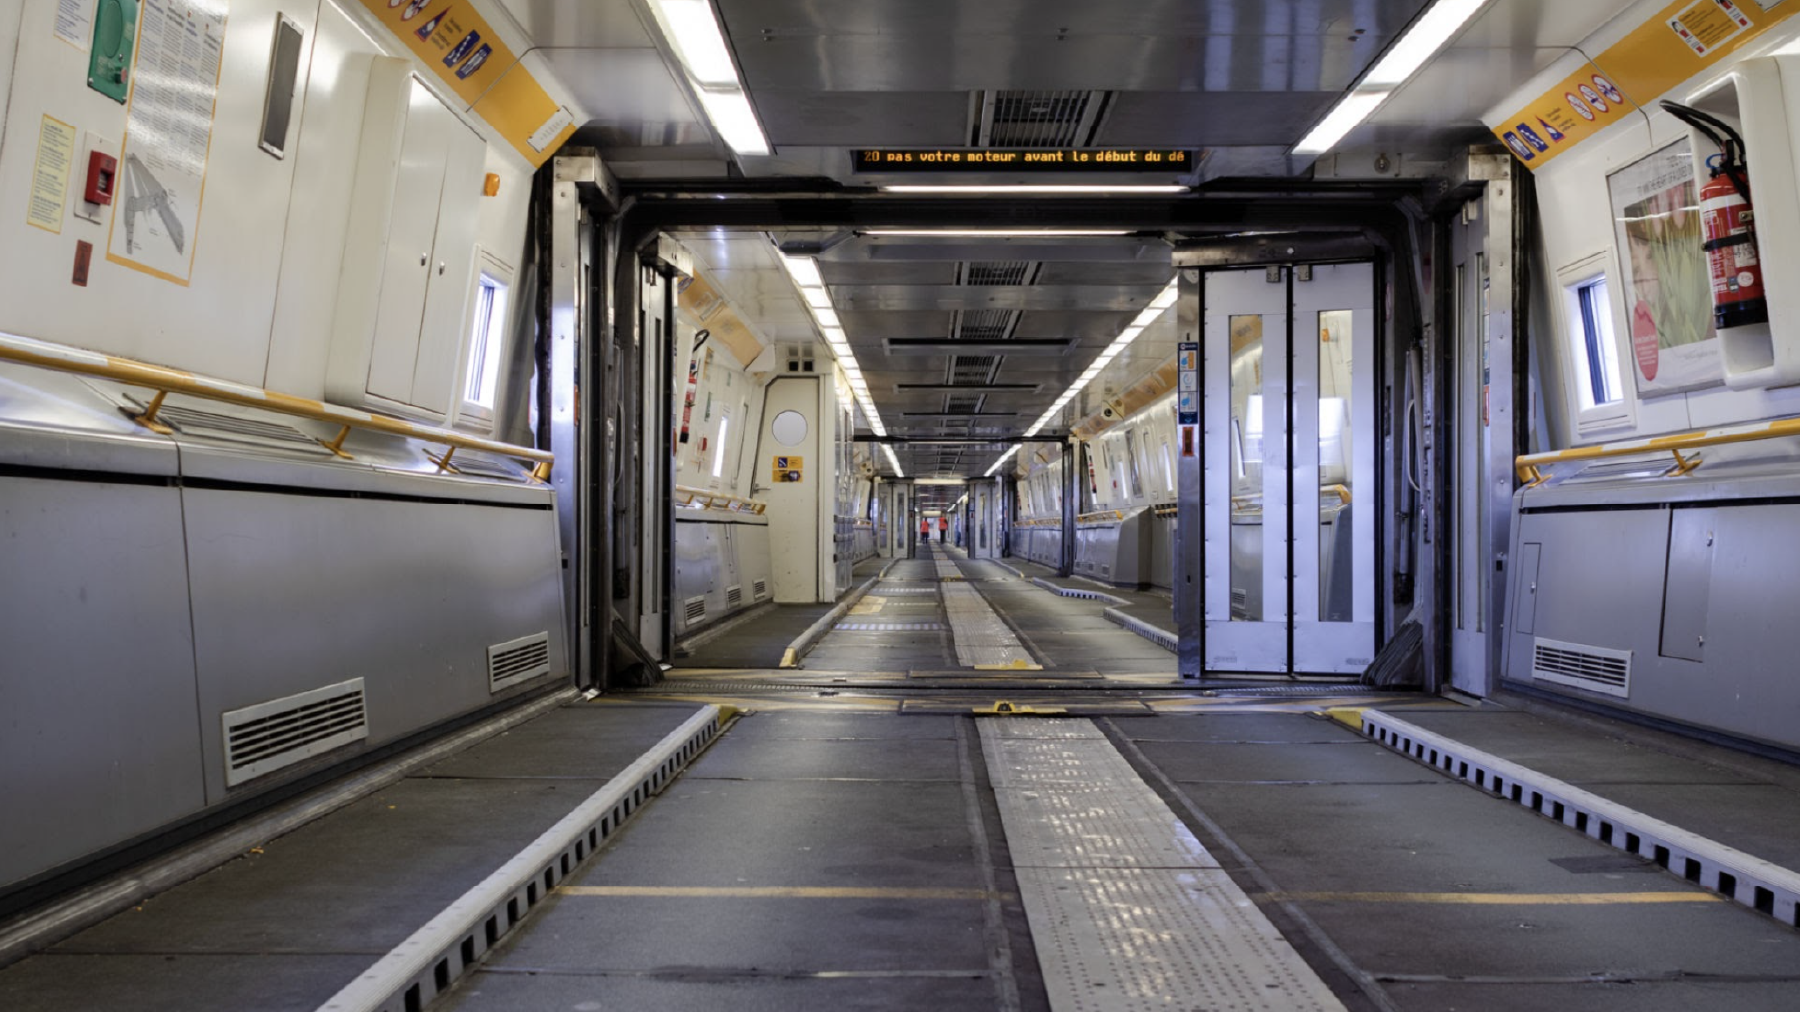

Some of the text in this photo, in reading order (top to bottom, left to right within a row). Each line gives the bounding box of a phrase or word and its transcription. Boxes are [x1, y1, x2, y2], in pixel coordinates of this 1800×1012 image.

[887, 153, 912, 162] pas
[920, 151, 960, 162] votre
[967, 151, 1016, 162] moteur
[1024, 151, 1064, 162] avant
[1073, 151, 1089, 162] le
[1096, 151, 1137, 162] début
[1144, 151, 1161, 162] du
